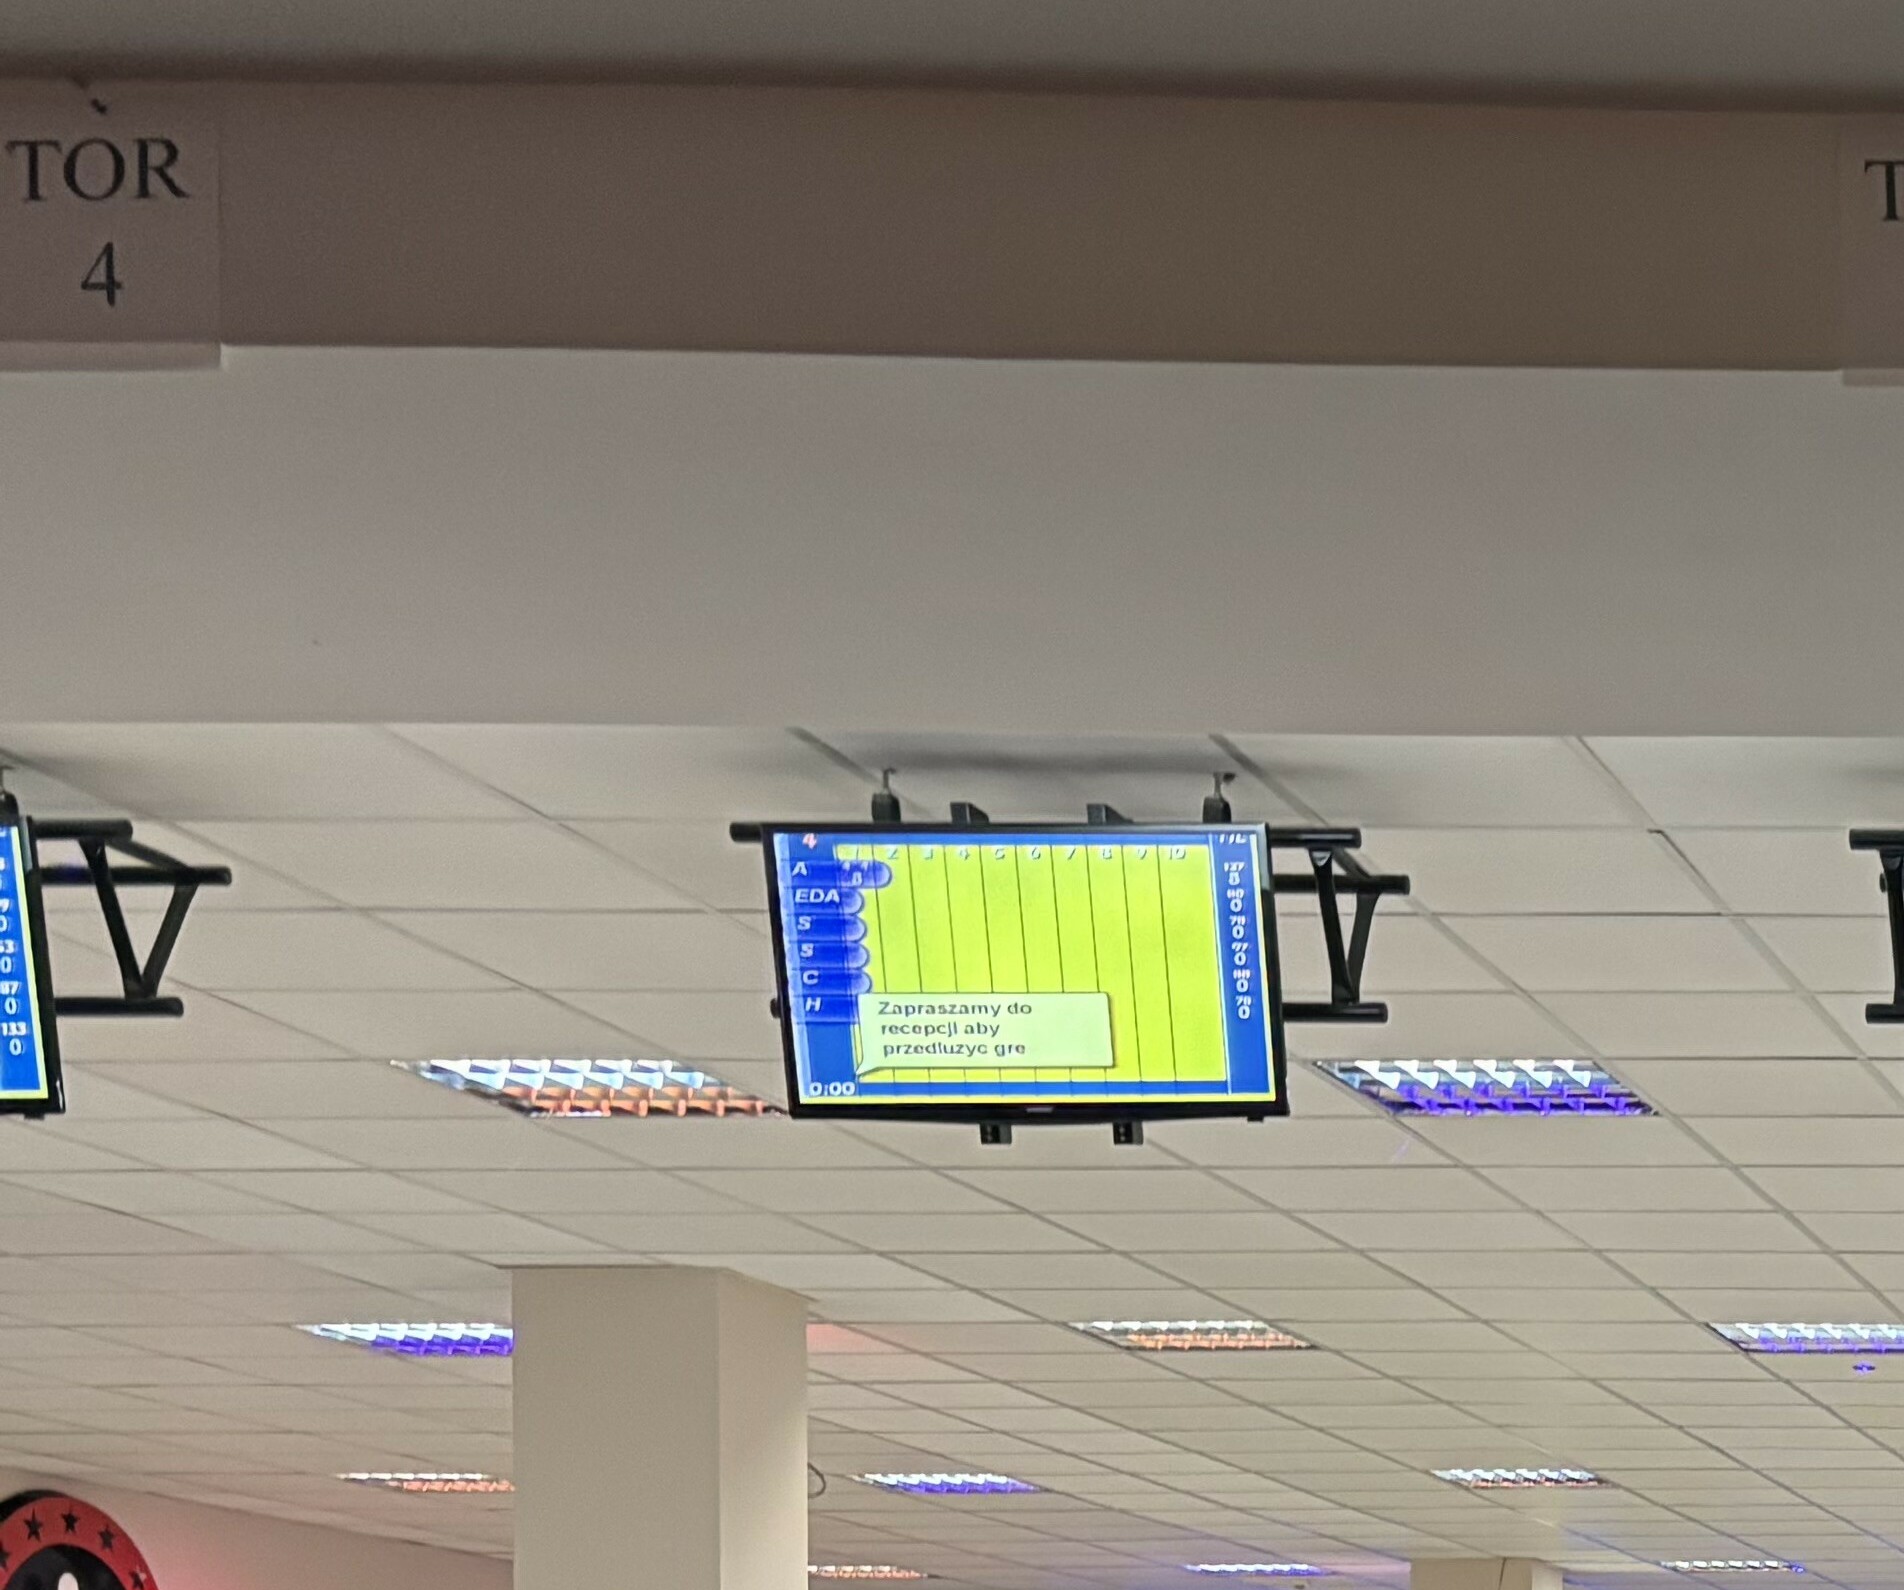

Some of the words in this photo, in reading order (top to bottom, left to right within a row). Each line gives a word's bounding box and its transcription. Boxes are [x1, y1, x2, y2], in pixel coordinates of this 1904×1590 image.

[80, 241, 124, 308] 4
[803, 833, 817, 849] 4
[792, 862, 808, 876] A
[794, 888, 840, 904] EDA
[797, 916, 812, 931] S
[800, 943, 814, 958] S
[802, 970, 819, 985] C
[805, 996, 821, 1012] H
[878, 1001, 1001, 1017] Zapraszamy
[1007, 1002, 1032, 1015] do
[881, 1021, 958, 1037] recepcji
[964, 1021, 1000, 1037] aby
[9, 1038, 22, 1056] 0
[809, 1082, 856, 1096] 0:00
